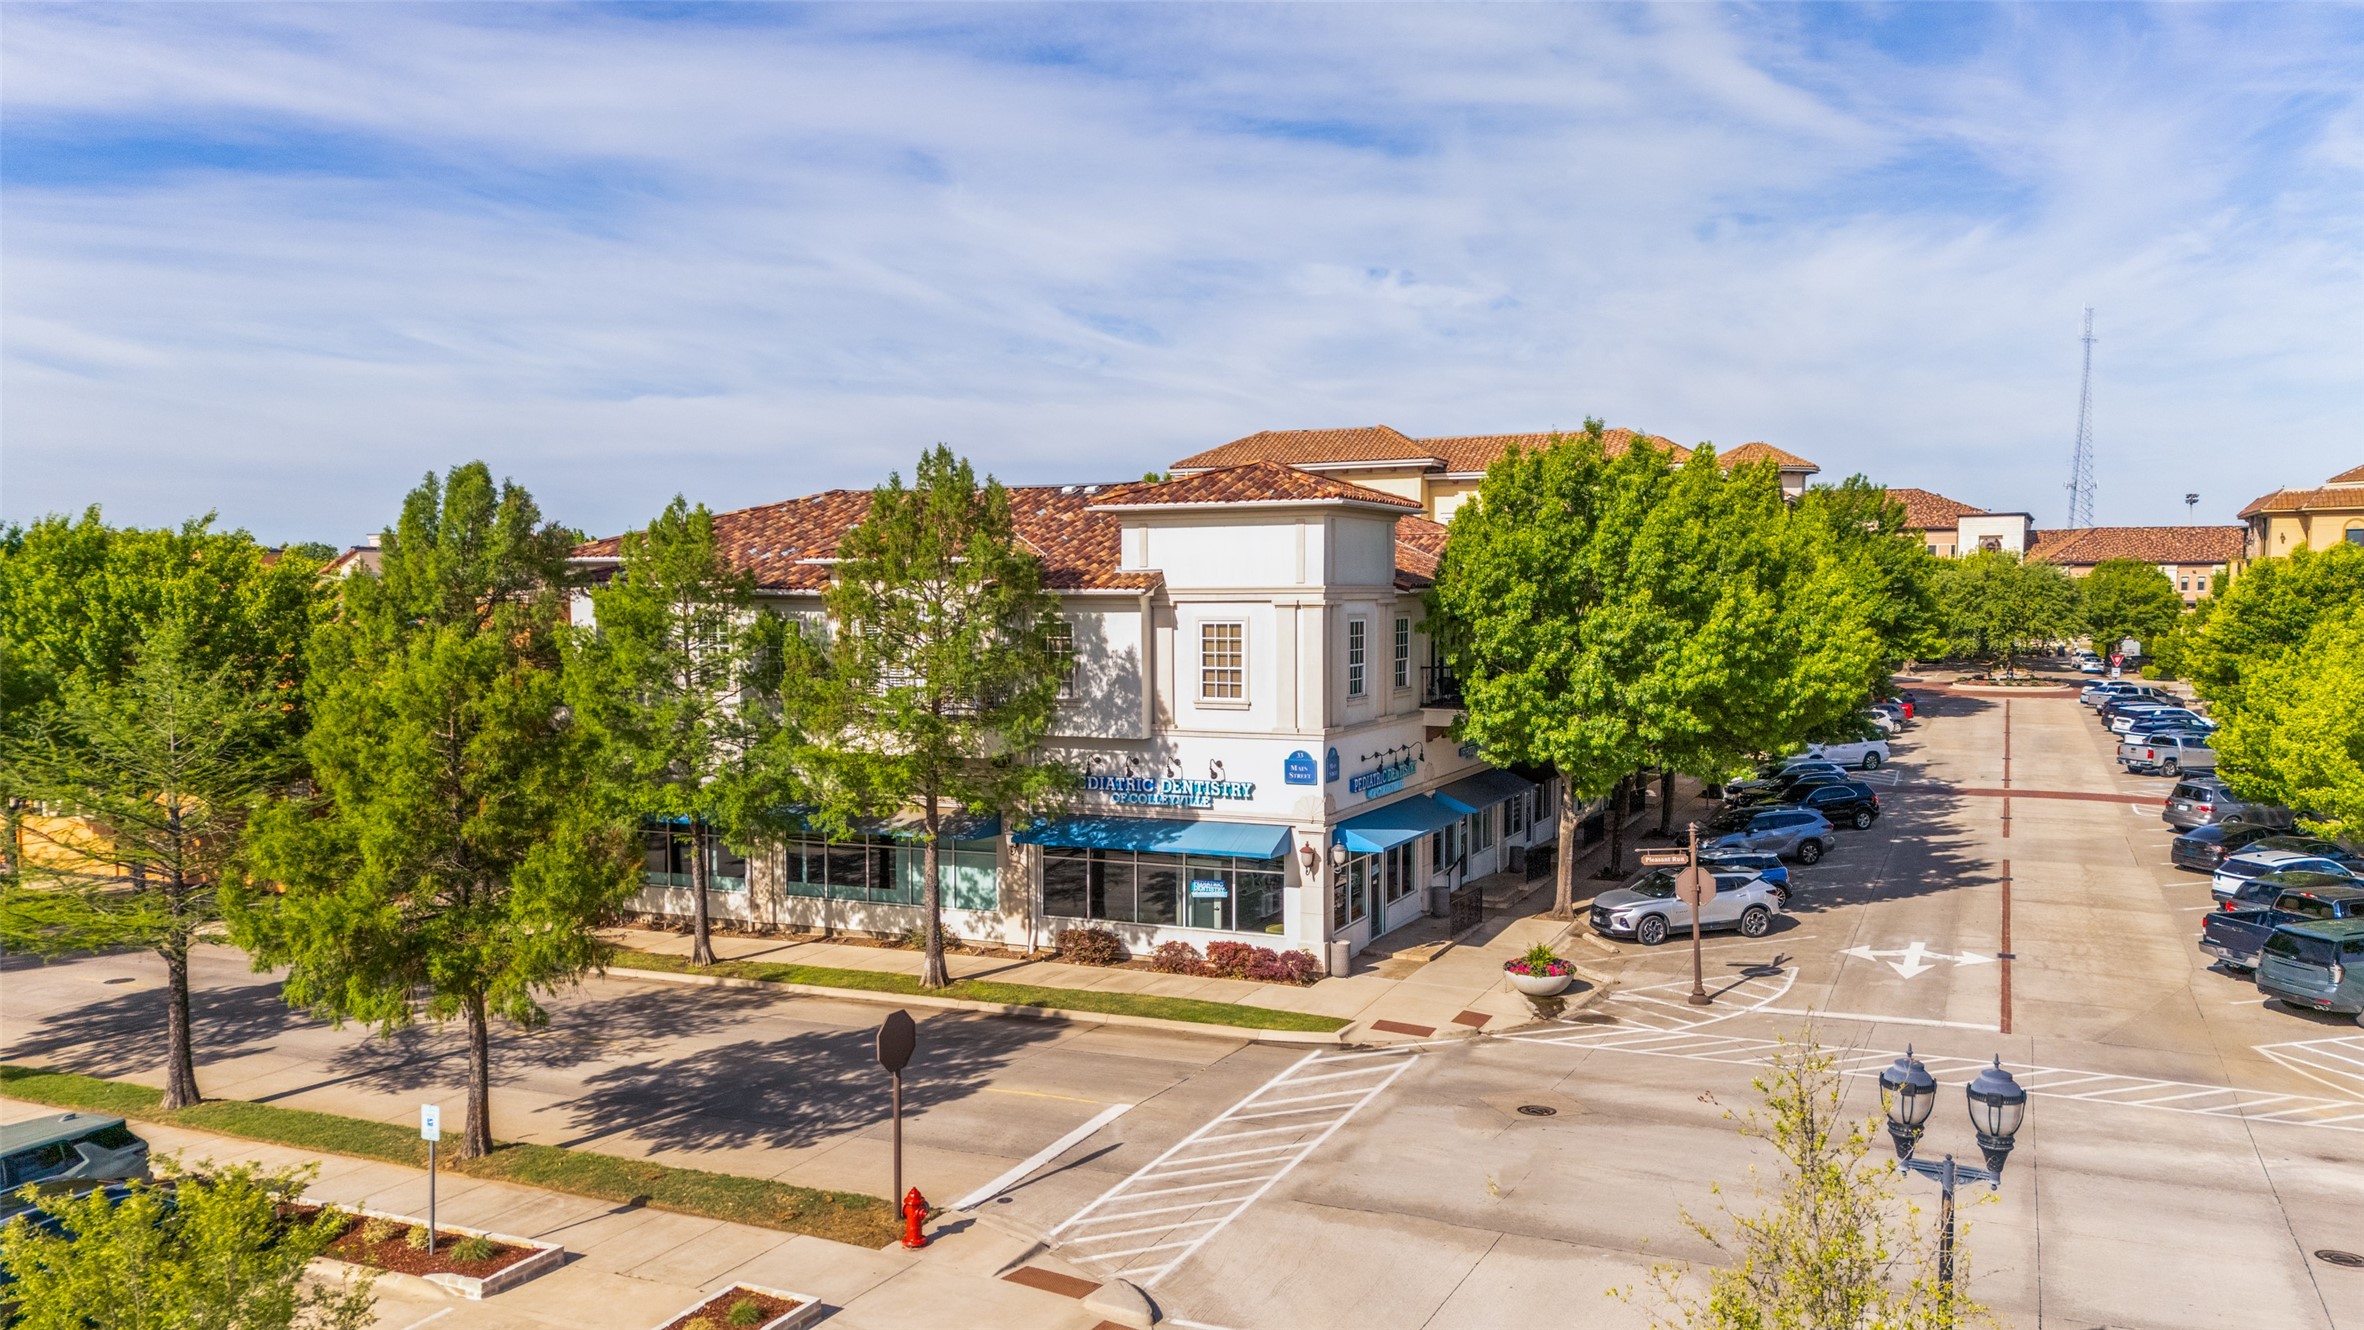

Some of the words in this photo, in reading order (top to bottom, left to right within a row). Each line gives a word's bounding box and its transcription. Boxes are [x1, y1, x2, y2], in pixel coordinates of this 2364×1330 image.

[1082, 776, 1154, 792] DIATRIC
[1160, 778, 1254, 799] DENTISTRY
[1111, 792, 1127, 804] OF
[1129, 793, 1212, 808] COLLEYVILLE
